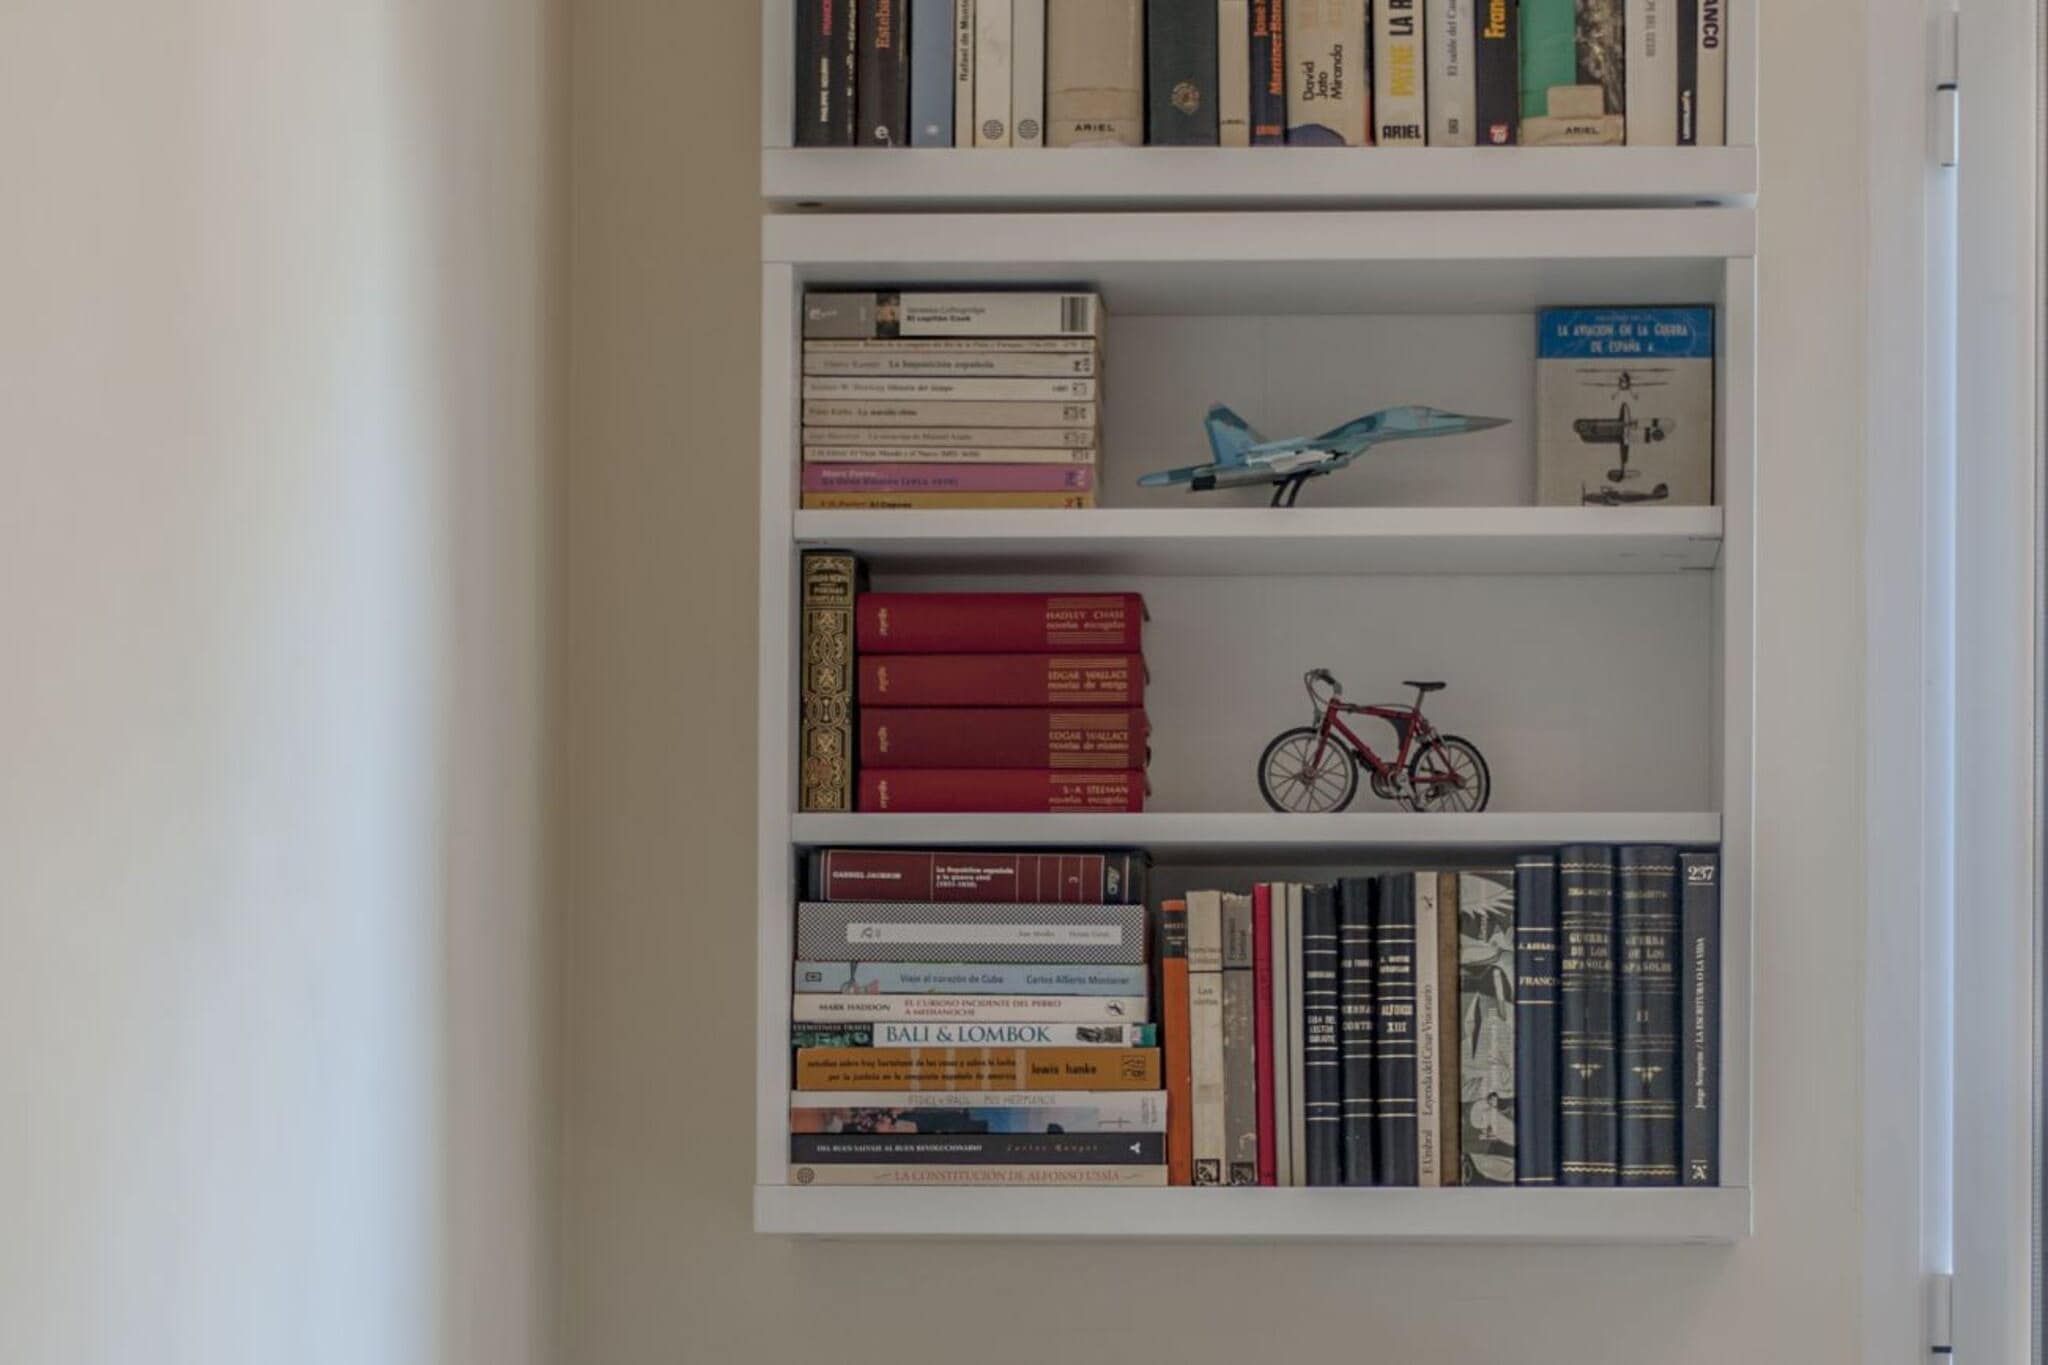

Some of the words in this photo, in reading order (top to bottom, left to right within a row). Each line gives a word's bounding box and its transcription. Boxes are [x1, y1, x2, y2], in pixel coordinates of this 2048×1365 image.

[1389, 16, 1413, 36] LA
[1446, 22, 1457, 37] del
[960, 33, 970, 46] de
[959, 49, 970, 81] Rafael
[1329, 43, 1343, 100] Miranda
[1446, 65, 1458, 78] El
[1301, 61, 1313, 102] David
[1316, 72, 1327, 99] Jato
[1075, 124, 1115, 134] ARIEL
[1383, 124, 1419, 139] ARIEL
[1565, 126, 1598, 136] ARIEL
[1557, 323, 1568, 337] LA
[1619, 323, 1632, 336] EN
[1637, 323, 1649, 337] LA
[1654, 321, 1688, 337] GUERRA
[1590, 339, 1602, 353] DE
[1609, 338, 1641, 353] ESPAÑA
[888, 360, 899, 368] La
[1045, 610, 1086, 620] HADLEY
[1093, 610, 1125, 620] CHASE
[1048, 670, 1080, 681] EDGAR
[1085, 670, 1127, 681] WALLACE
[1083, 681, 1096, 690] de
[1049, 730, 1081, 741] EDGAR
[1086, 730, 1128, 741] WALLACE
[1083, 742, 1095, 751] de
[833, 871, 865, 880] GABRIEL
[937, 865, 946, 874] La
[947, 866, 981, 875] República
[983, 867, 1014, 876] española
[1688, 864, 1714, 881] 237
[951, 874, 974, 883] guerra
[1569, 932, 1608, 945] GUERRA
[1571, 945, 1584, 957] DE
[1591, 945, 1608, 957] LOS
[1646, 948, 1665, 960] LOS
[1695, 937, 1705, 959] VIDA
[1695, 960, 1705, 972] LA
[901, 974, 921, 985] Viaje
[923, 974, 930, 984] al
[932, 974, 966, 984] corazón
[968, 974, 978, 984] de
[980, 974, 1004, 984] Cuba
[1026, 974, 1053, 984] Carlos
[1055, 974, 1086, 984] Alberto
[1695, 973, 1705, 982] O
[819, 1003, 844, 1011] MARK
[847, 1003, 891, 1011] HADDON
[904, 999, 913, 1007] EL
[916, 999, 959, 1007] CURIOSO
[962, 999, 1010, 1008] INCIDENTE
[1013, 999, 1028, 1008] DEL
[1031, 999, 1061, 1008] PERRO
[1420, 984, 1433, 1033] Visionario
[1695, 982, 1705, 1030] ESCRITURA
[904, 1008, 912, 1016] A
[913, 1008, 975, 1017] MEDIANOCHE
[1381, 1004, 1413, 1016] ALFONSO
[886, 1025, 929, 1043] BALI
[936, 1025, 954, 1043] &
[958, 1025, 1053, 1044] LOMBOK
[1695, 1031, 1705, 1043] LA
[840, 1058, 859, 1067] sobre
[916, 1058, 924, 1067] de
[926, 1058, 936, 1067] las
[966, 1058, 986, 1067] sobre
[988, 1058, 995, 1067] la
[1421, 1060, 1432, 1076] del
[1031, 1063, 1059, 1077] lewis
[1065, 1063, 1097, 1077] hanke
[828, 1073, 840, 1082] por
[844, 1072, 850, 1080] la
[894, 1072, 901, 1080] la
[975, 1072, 984, 1080] de
[1421, 1079, 1436, 1116] Leyenda
[1694, 1087, 1707, 1108] Jorge
[816, 1145, 831, 1153] DEL
[833, 1145, 852, 1153] BUEN
[884, 1145, 893, 1153] AL
[895, 1145, 914, 1153] BUEN
[916, 1144, 983, 1153] REVOLUCIONARIO
[1421, 1129, 1433, 1165] Umbral
[894, 1170, 911, 1182] LA
[1009, 1169, 1023, 1182] DE
[1024, 1169, 1083, 1183] ALFONSO
